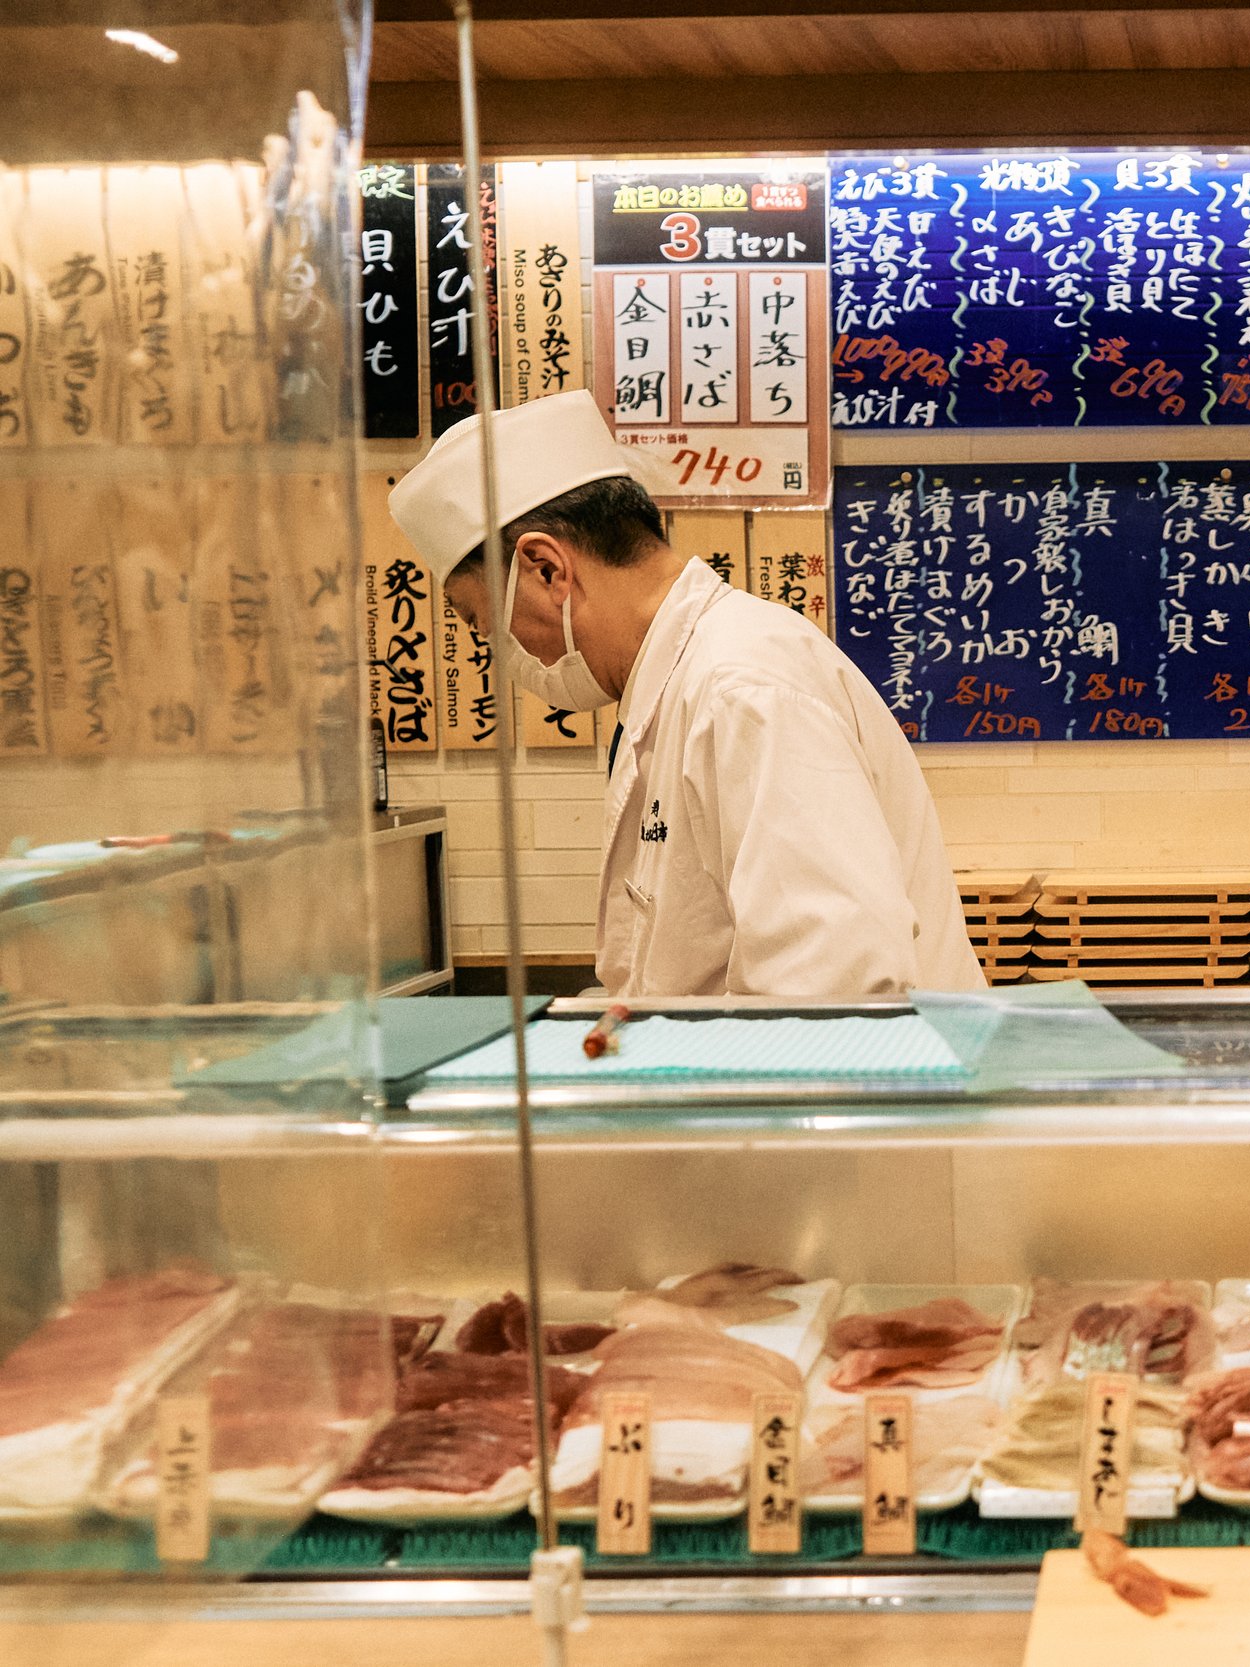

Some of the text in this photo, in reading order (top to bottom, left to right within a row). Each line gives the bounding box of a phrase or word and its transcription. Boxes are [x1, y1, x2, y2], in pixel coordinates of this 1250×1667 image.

[613, 184, 748, 209] 本日のお薦め
[1113, 154, 1203, 196] 貝3貫
[514, 249, 527, 288] Miso
[660, 212, 807, 262] 3貫セット
[1004, 211, 1045, 307] あじ
[1043, 204, 1086, 328] きびなご
[1140, 211, 1174, 313] とり貝
[1168, 208, 1206, 320] 生ほたて
[357, 230, 399, 376] 貝ひも
[513, 293, 526, 333] soup
[535, 243, 571, 391] あさりのみそ汁
[517, 338, 531, 354] of
[608, 286, 666, 418] 金目鯛
[680, 291, 732, 408] 赤さば
[753, 291, 807, 416] 中落ち
[620, 433, 689, 445] 3貫セット価格
[671, 446, 763, 486] 740
[783, 470, 802, 490] 円
[365, 565, 377, 604] Broild
[807, 554, 825, 619] 激辛
[842, 499, 885, 638] きびなご
[959, 489, 997, 664] するめいか
[993, 491, 1039, 660] かつお
[443, 623, 458, 662] Fatty
[446, 668, 460, 727] Salmon
